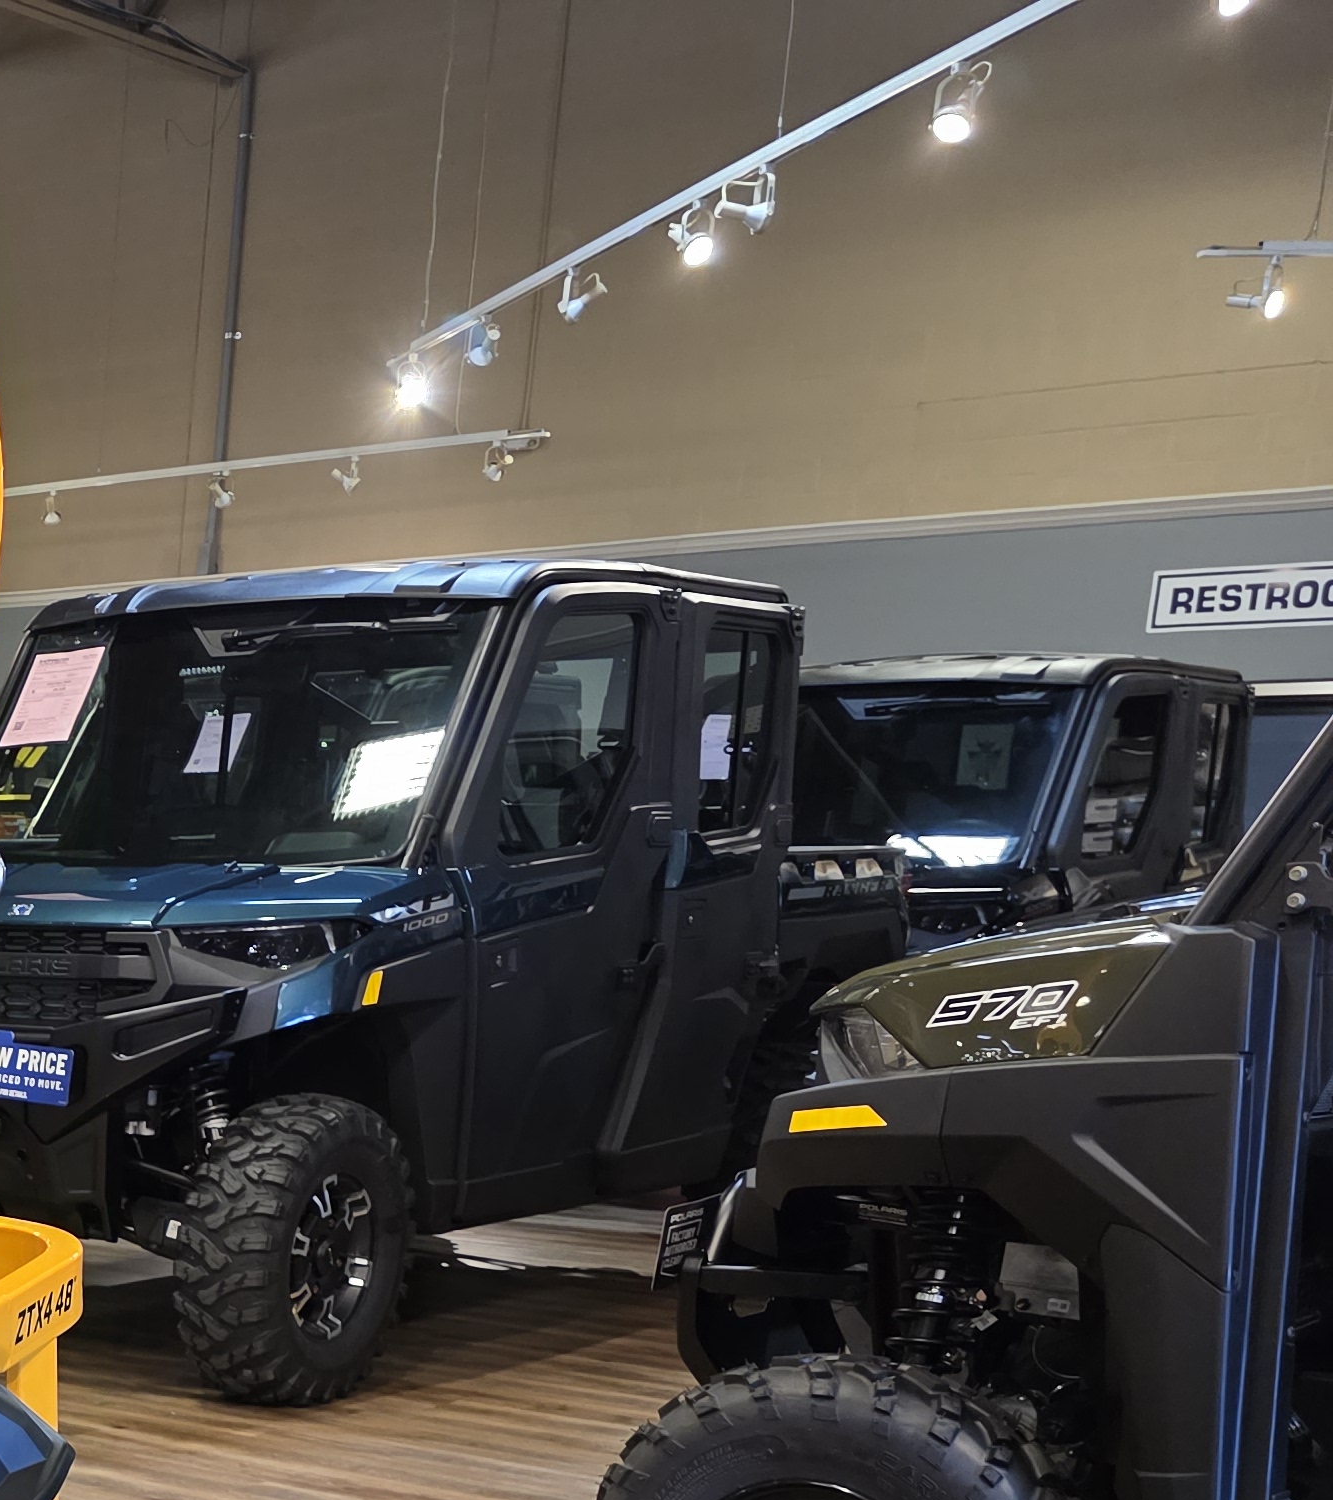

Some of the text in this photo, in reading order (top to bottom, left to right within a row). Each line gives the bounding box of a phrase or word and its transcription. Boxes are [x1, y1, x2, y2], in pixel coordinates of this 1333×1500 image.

[403, 912, 449, 932] 1000
[925, 980, 1079, 1028] 570
[15, 1047, 69, 1076] PRICE
[23, 1076, 36, 1087] TO
[38, 1078, 64, 1091] MOVE.
[670, 1207, 704, 1223] POLARIS
[859, 1203, 908, 1216] POLARIS
[15, 1291, 53, 1346] ZTX4
